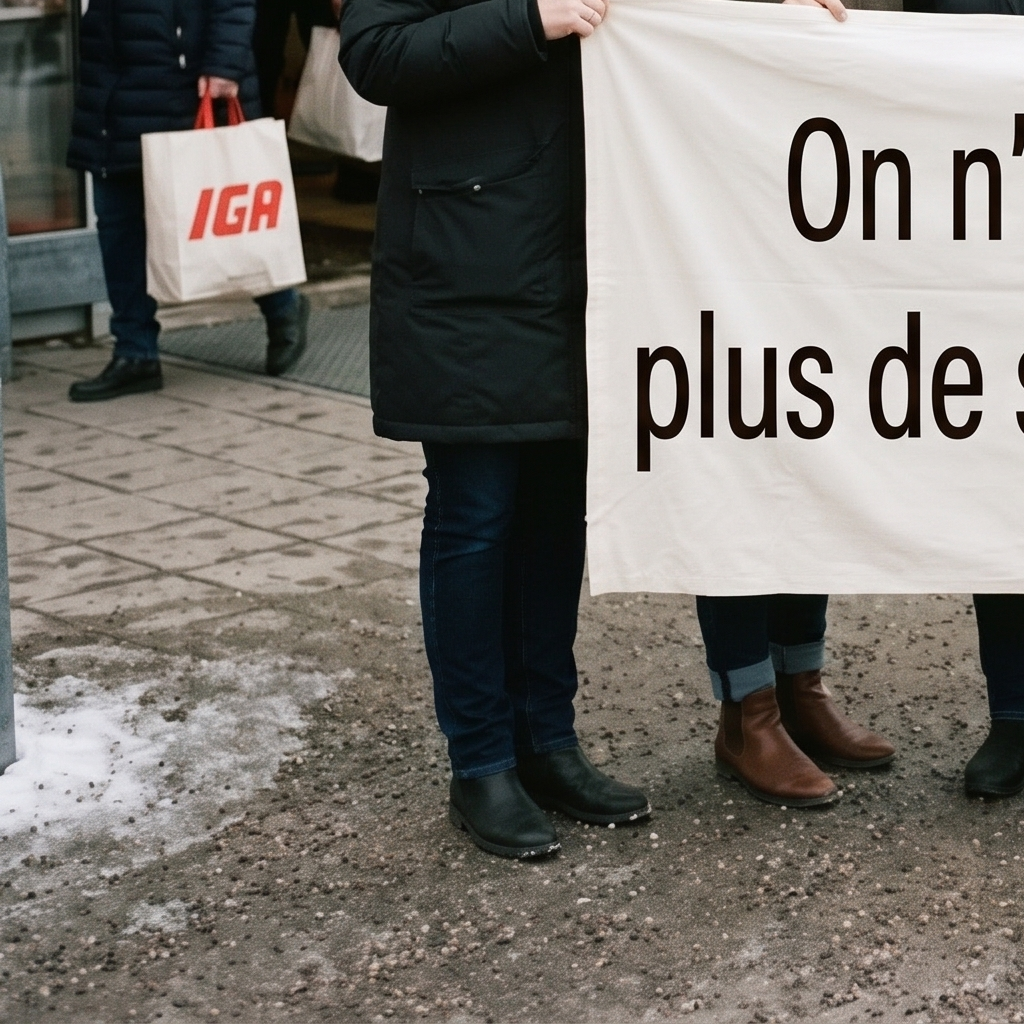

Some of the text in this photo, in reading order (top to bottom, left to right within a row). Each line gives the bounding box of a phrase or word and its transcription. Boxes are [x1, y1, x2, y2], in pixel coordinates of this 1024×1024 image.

[188, 179, 283, 241] IGA
[787, 117, 912, 243] On
[636, 310, 835, 472] plus
[868, 311, 983, 440] de
